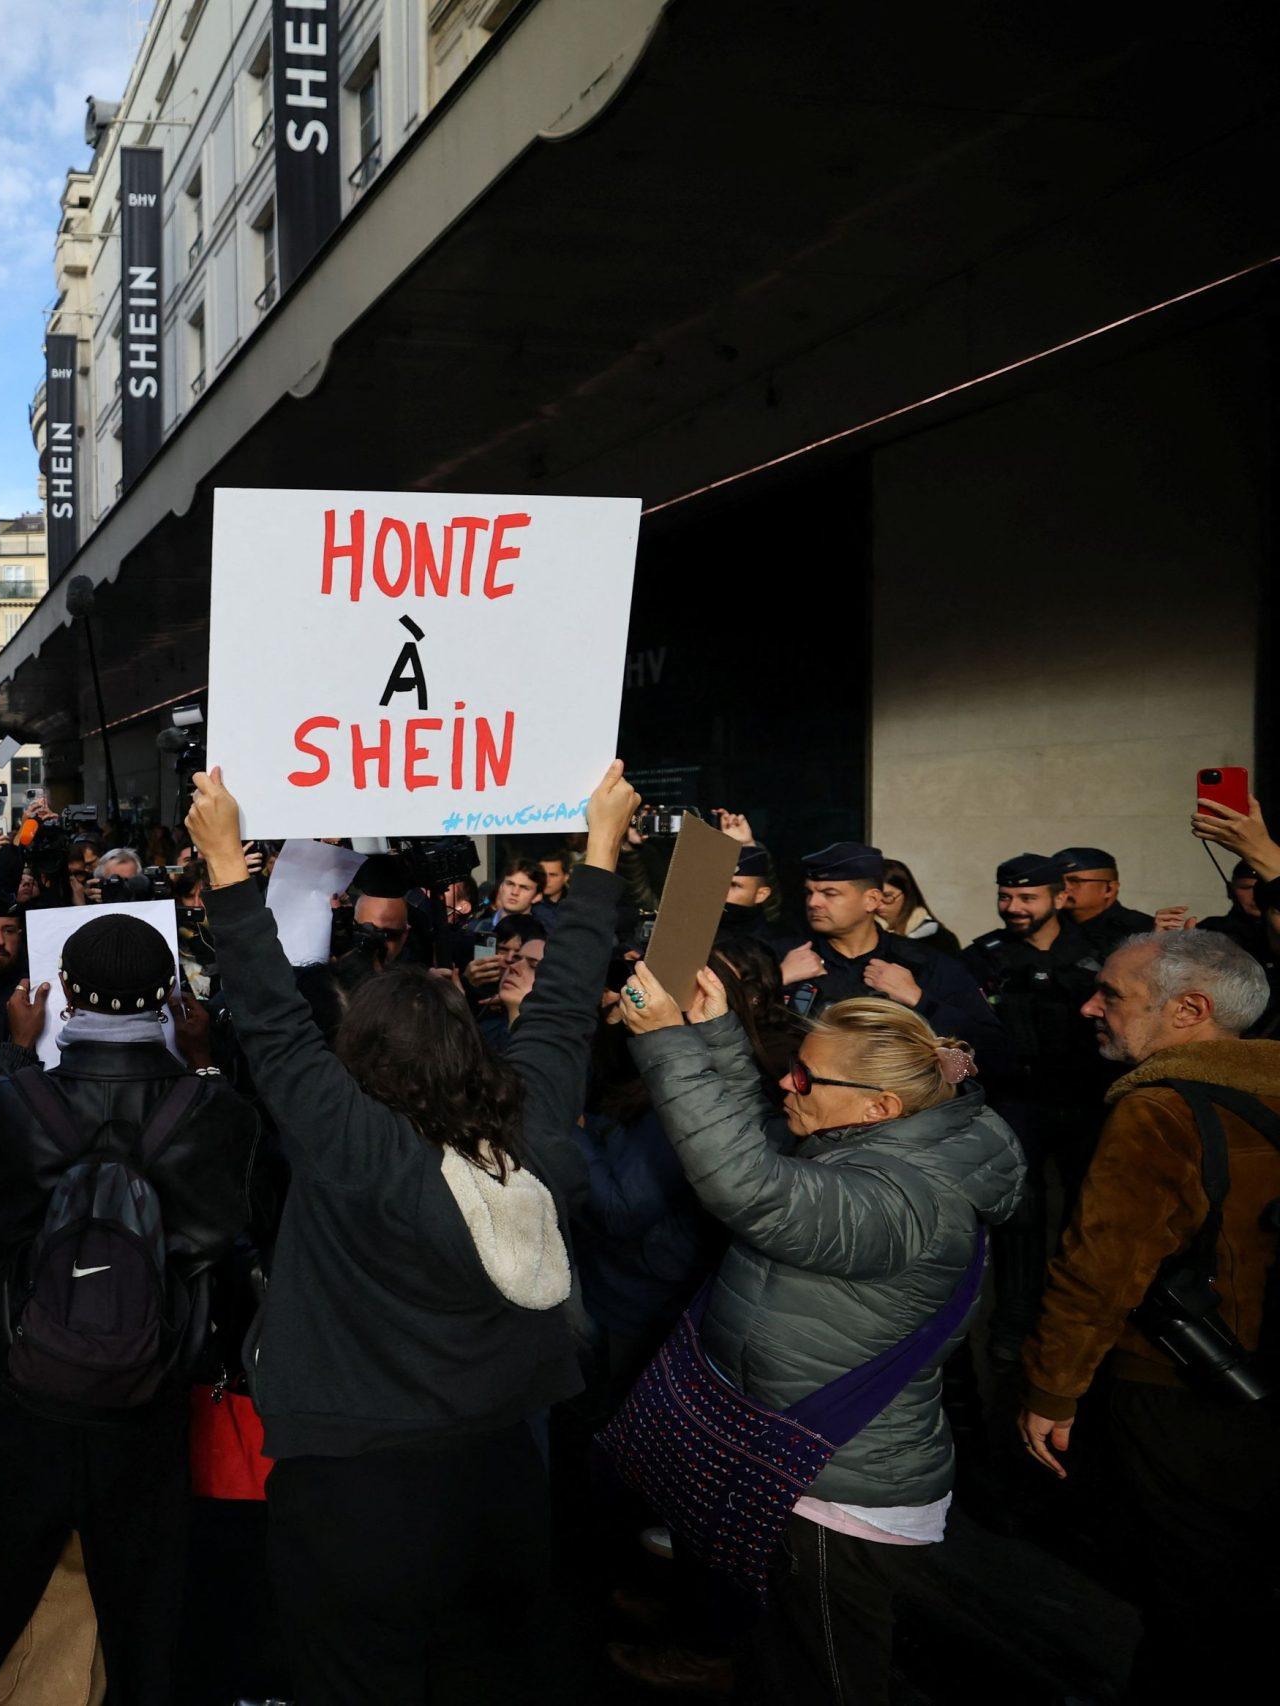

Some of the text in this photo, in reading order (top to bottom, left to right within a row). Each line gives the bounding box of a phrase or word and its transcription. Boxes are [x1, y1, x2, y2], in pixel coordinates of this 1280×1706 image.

[285, 0, 328, 154] SHEI
[128, 192, 157, 207] BHV
[51, 368, 72, 379] BHV
[128, 266, 158, 399] SHEIN
[51, 422, 73, 519] SHEIN
[320, 509, 532, 602] HONTE
[378, 614, 428, 711] À
[627, 646, 667, 690] HV
